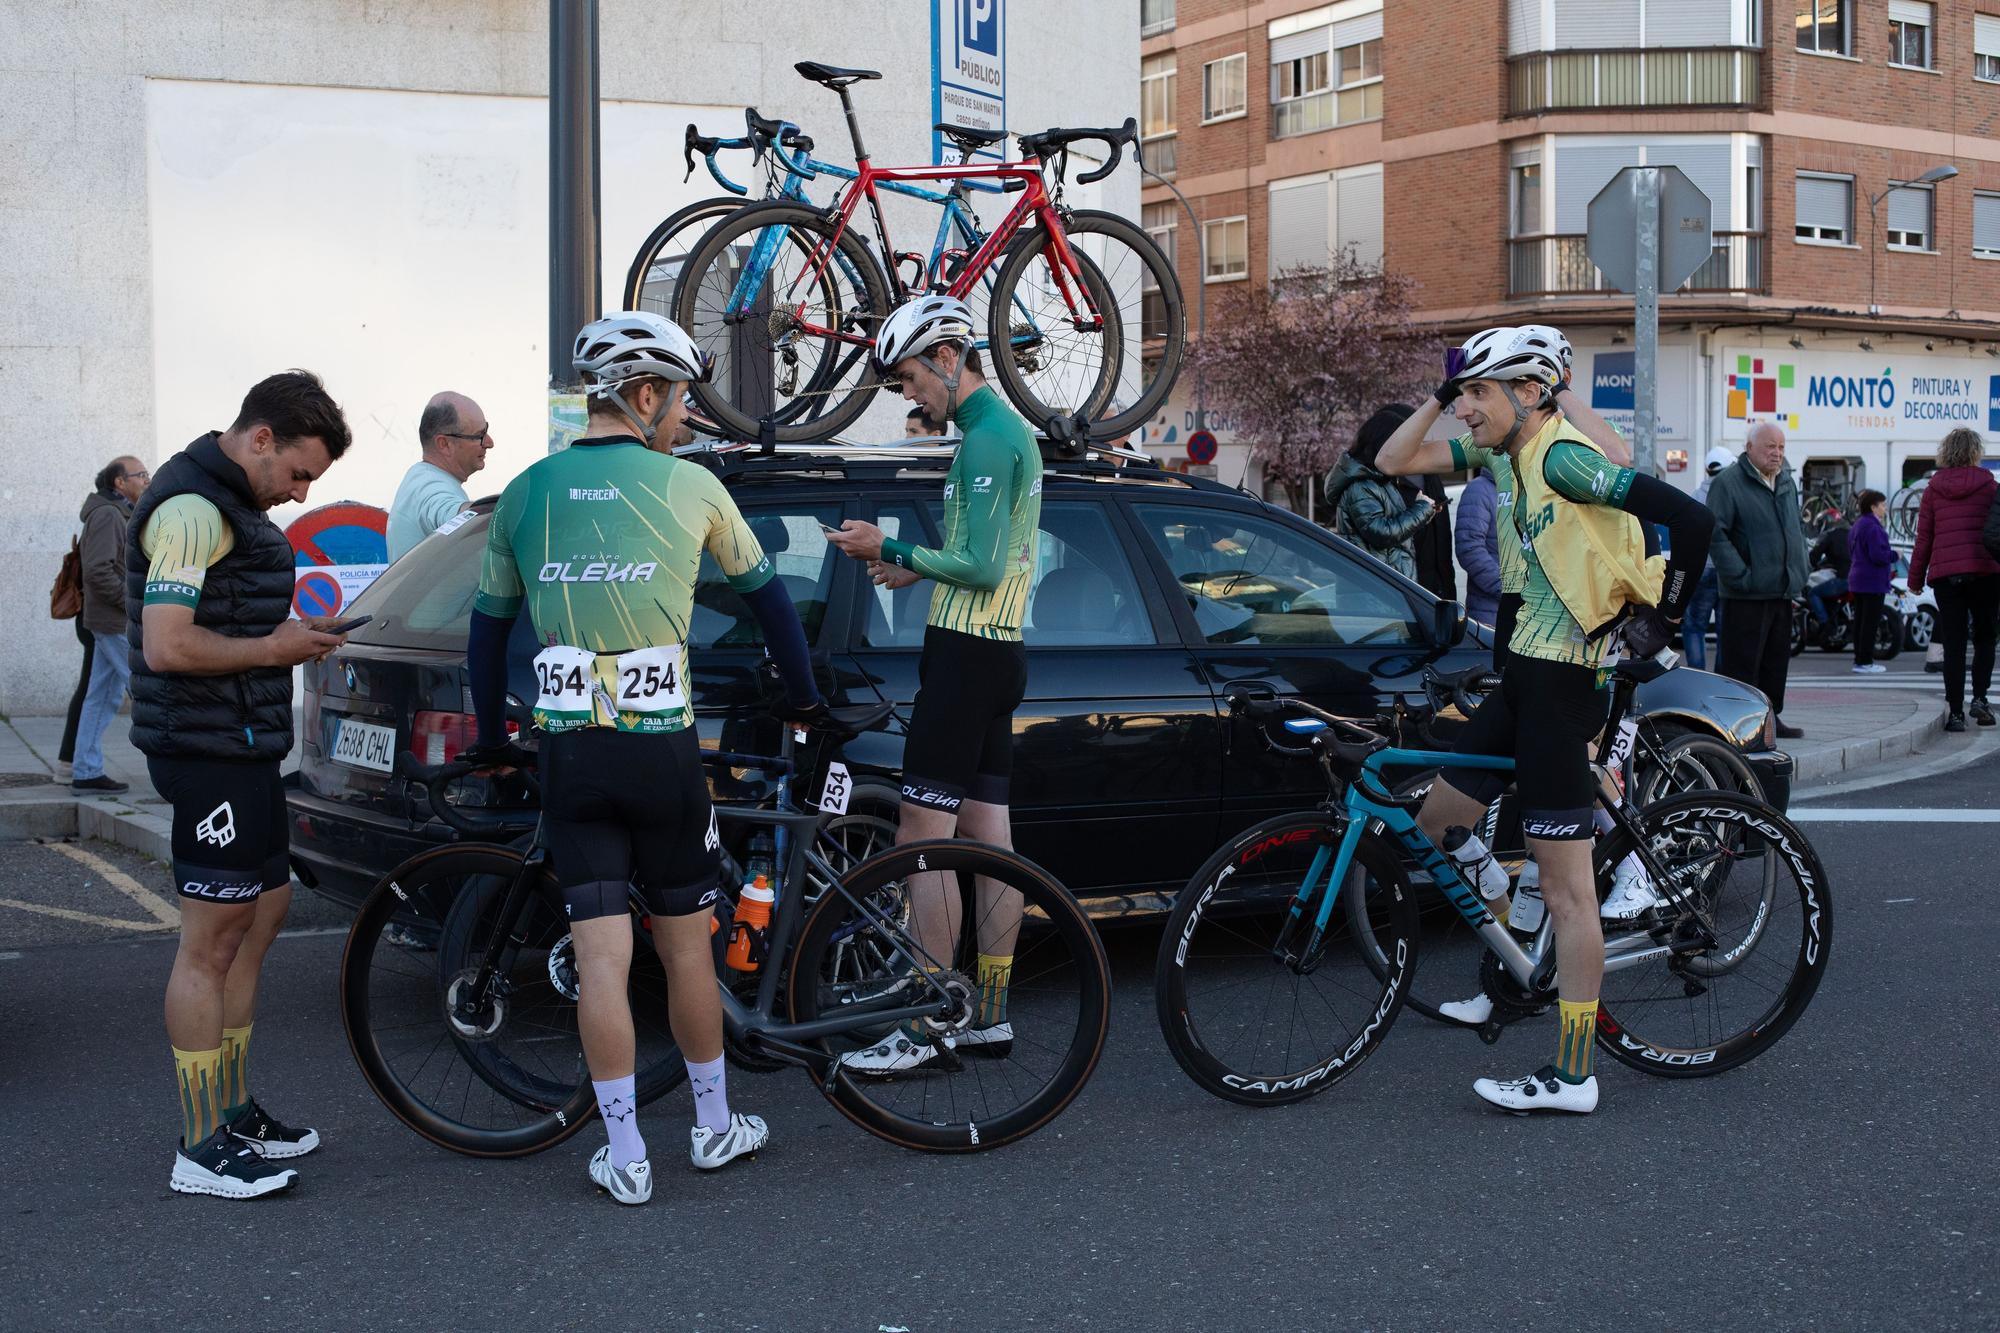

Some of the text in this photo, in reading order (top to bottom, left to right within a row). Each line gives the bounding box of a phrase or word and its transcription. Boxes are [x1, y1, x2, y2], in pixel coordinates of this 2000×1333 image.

[961, 57, 1001, 86] PÚBLICO
[944, 91, 965, 107] PARQUE
[965, 98, 972, 109] DE
[973, 99, 983, 112] SAN
[955, 113, 971, 126] casco
[1595, 374, 1635, 388] MON
[1807, 367, 1895, 408] MONTÓ
[1912, 377, 1972, 396] PINTURA Y
[1848, 415, 1896, 428] TIENDAS
[1904, 399, 1979, 421] DECORACIÓN
[569, 488, 620, 501] 101PERCENT
[145, 583, 196, 597] GIRO
[537, 662, 585, 697] 254
[622, 662, 677, 700] 254
[643, 717, 683, 726] CAJA RURAL
[337, 725, 390, 766] 2688 CHL
[1610, 726, 1632, 762] 257
[823, 772, 848, 811] 254
[1241, 828, 1318, 866] ONE
[1397, 825, 1497, 930] FACTOR
[1661, 806, 1820, 966] CAMPAGNOLO
[1175, 863, 1237, 968] BORA
[1618, 906, 1644, 919] GIRO
[1725, 901, 1766, 961] CORIMA
[1637, 950, 1668, 963] FACTOR
[1222, 937, 1409, 1094] CAMPAGNOLO
[1620, 1032, 1718, 1066] BORA
